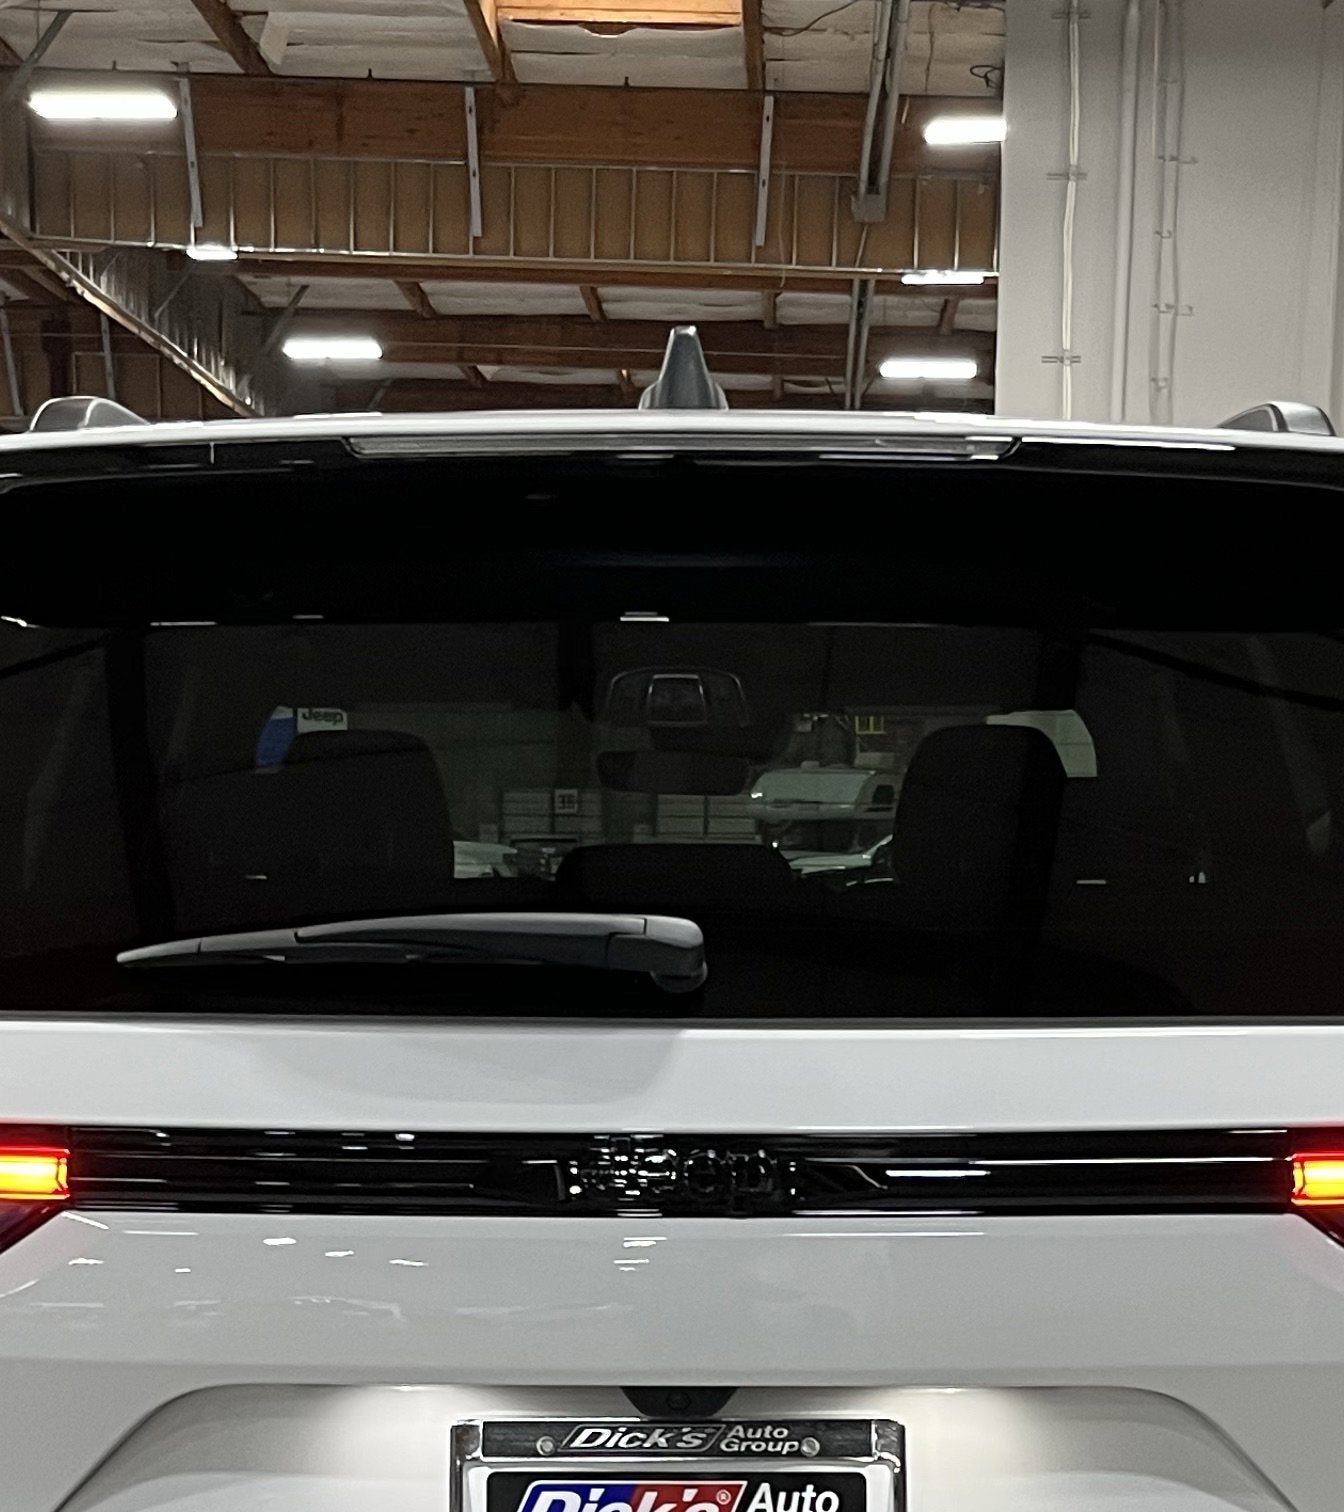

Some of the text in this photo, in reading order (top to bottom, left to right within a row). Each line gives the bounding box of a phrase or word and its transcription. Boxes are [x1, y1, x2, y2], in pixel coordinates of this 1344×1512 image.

[570, 1425, 789, 1448] Dick's Auto
[719, 1438, 799, 1455] Group
